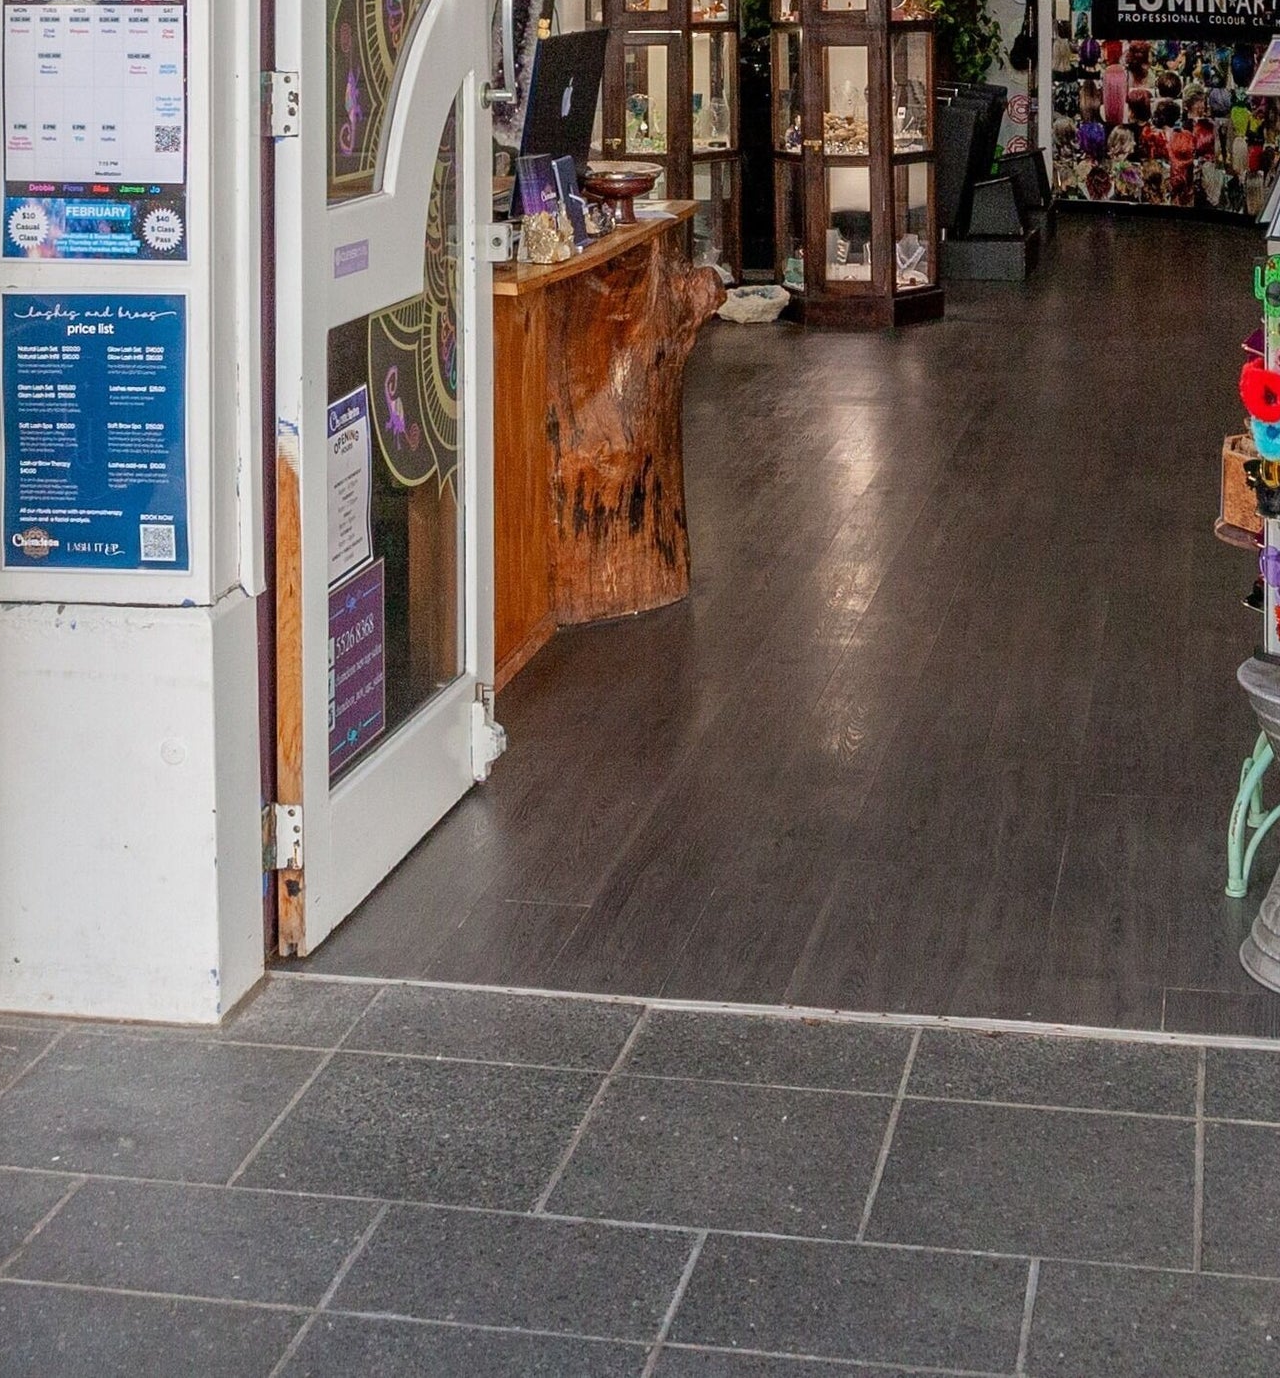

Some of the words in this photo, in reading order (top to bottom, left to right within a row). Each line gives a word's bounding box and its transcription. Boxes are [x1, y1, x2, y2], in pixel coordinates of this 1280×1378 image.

[1118, 13, 1200, 23] PROFESSIONAL
[1209, 15, 1245, 25] COLOUR
[150, 185, 160, 194] Jo
[66, 206, 127, 218] FEBRUARY
[19, 234, 38, 242] Class
[155, 235, 171, 243] Pass
[85, 306, 114, 318] and
[67, 323, 96, 336] price
[98, 323, 115, 334] list
